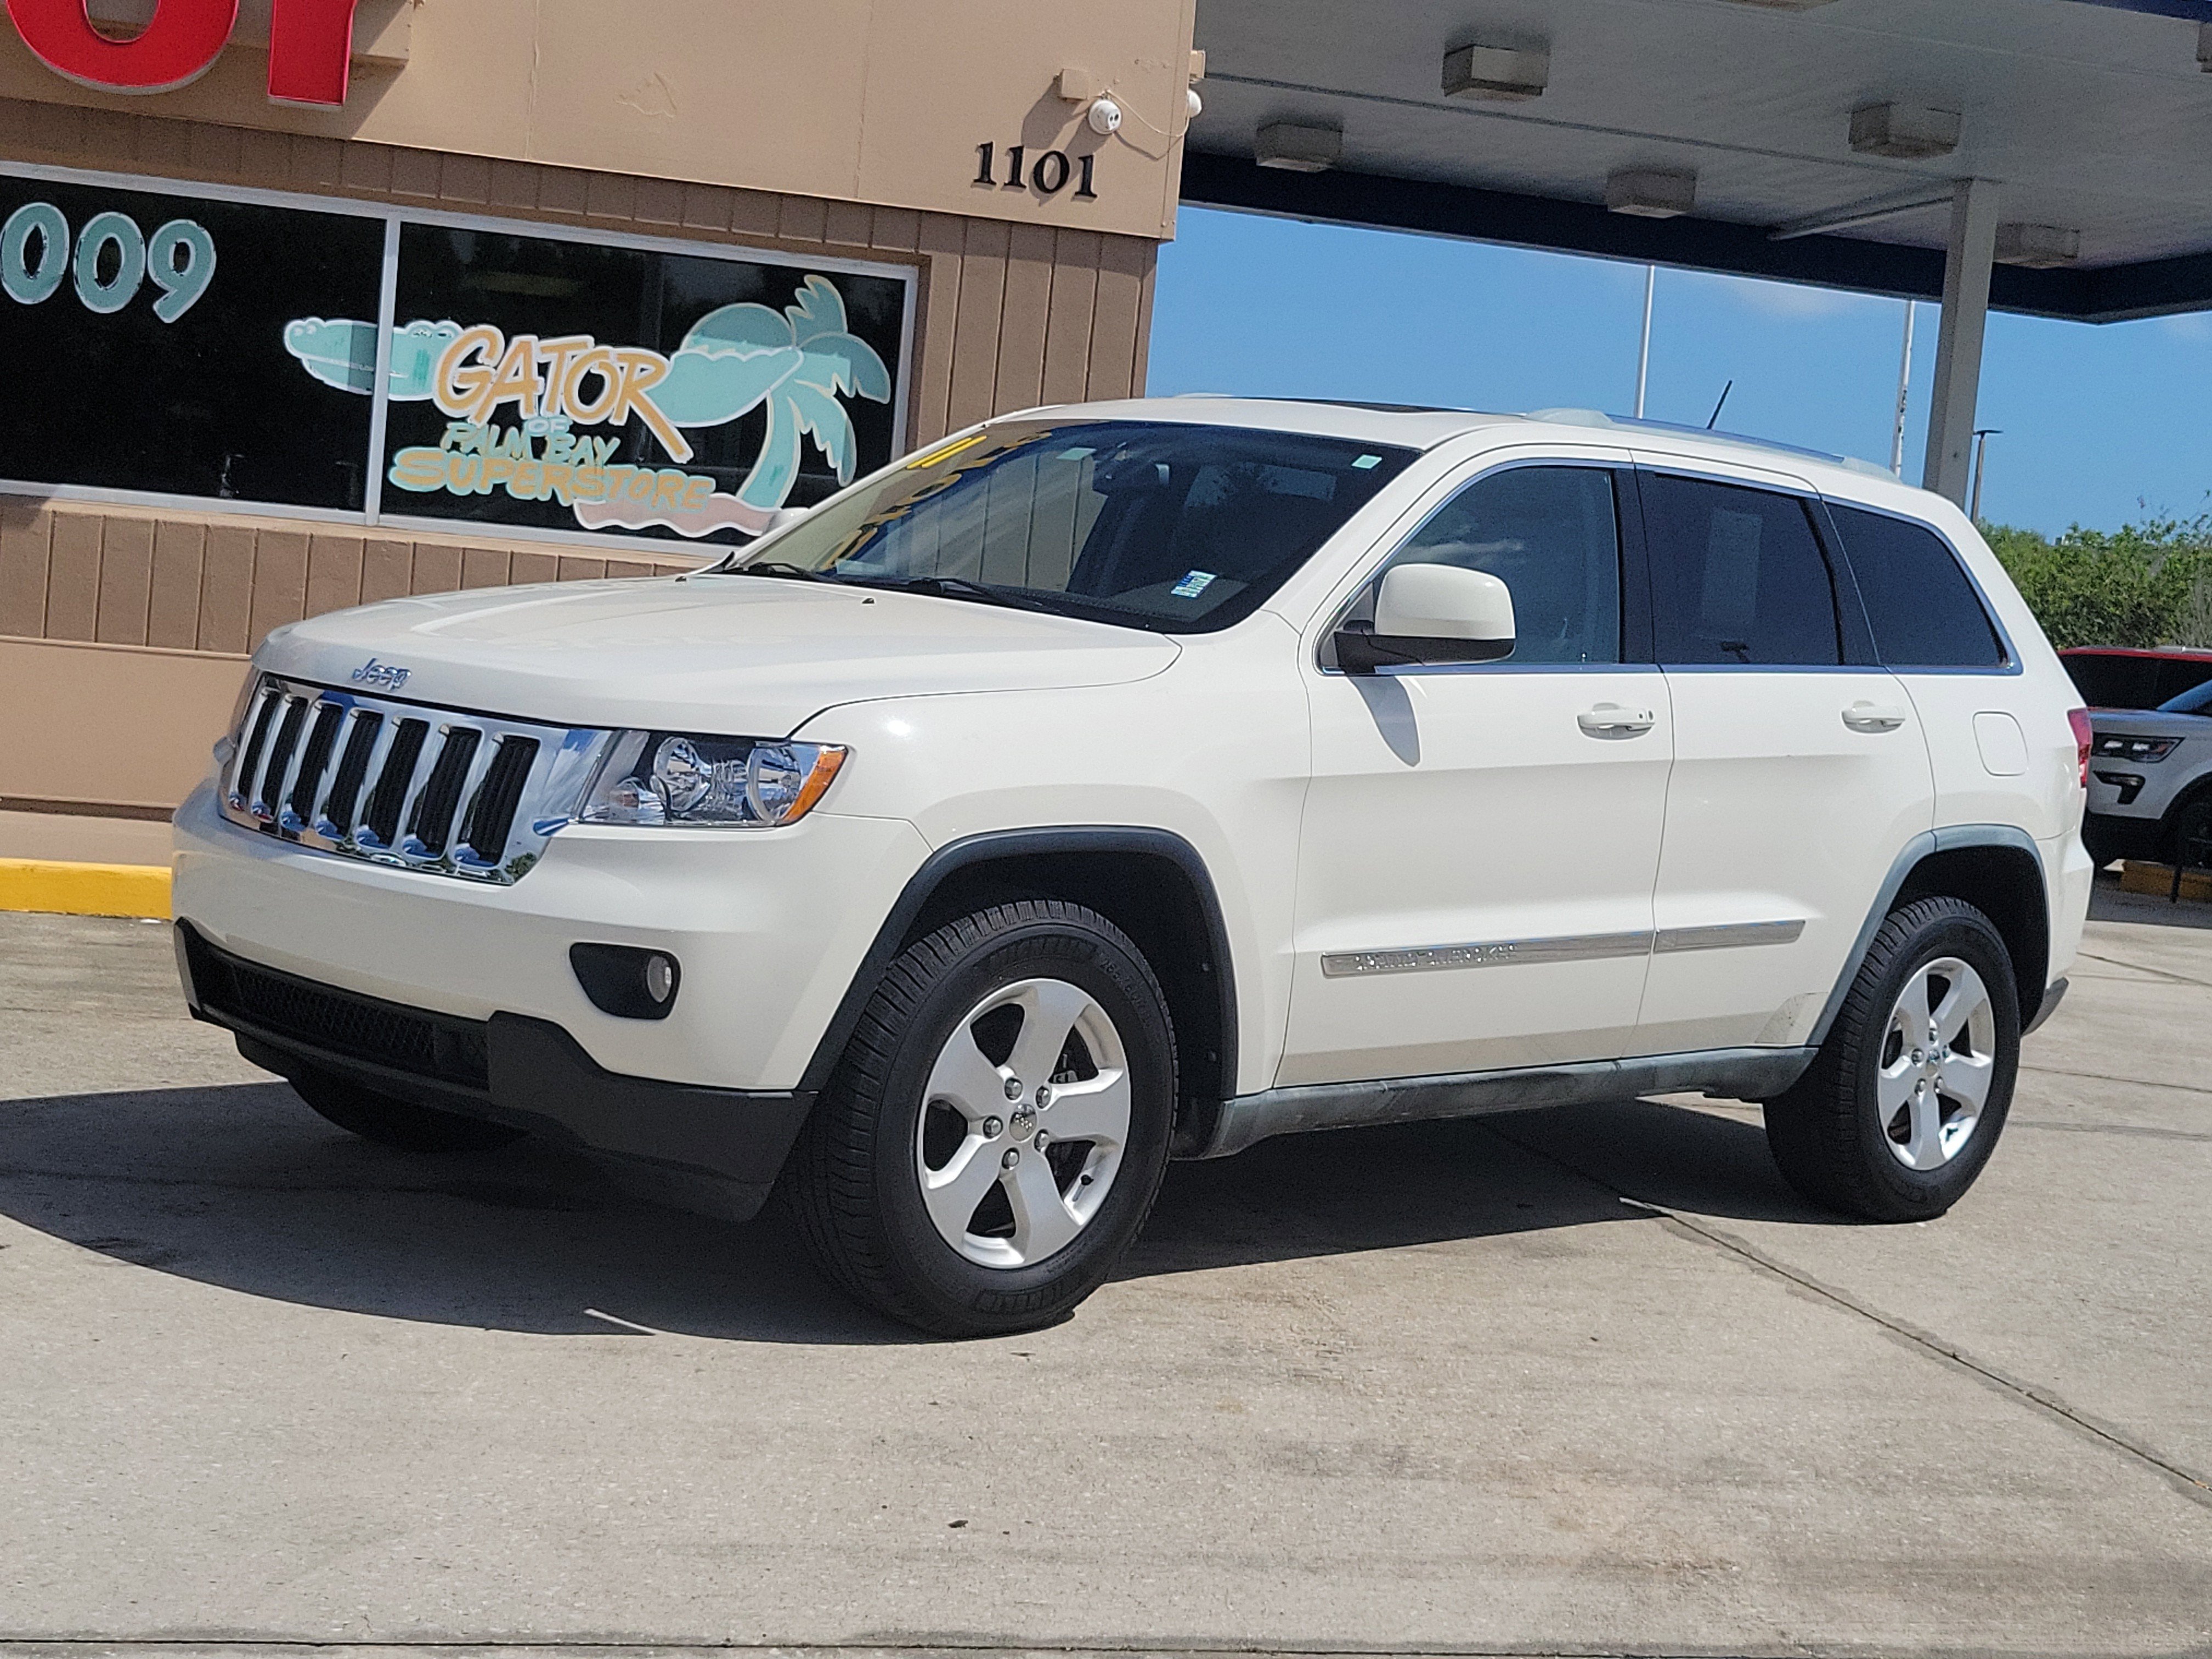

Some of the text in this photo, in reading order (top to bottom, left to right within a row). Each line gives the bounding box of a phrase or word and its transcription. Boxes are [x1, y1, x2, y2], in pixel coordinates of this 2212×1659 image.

[972, 140, 1098, 199] 1101
[433, 324, 695, 464] GATOR
[440, 422, 622, 468] PALM BAY
[525, 415, 572, 437] OF
[387, 446, 716, 511] SUPERSTORE
[352, 657, 411, 692] Jeep
